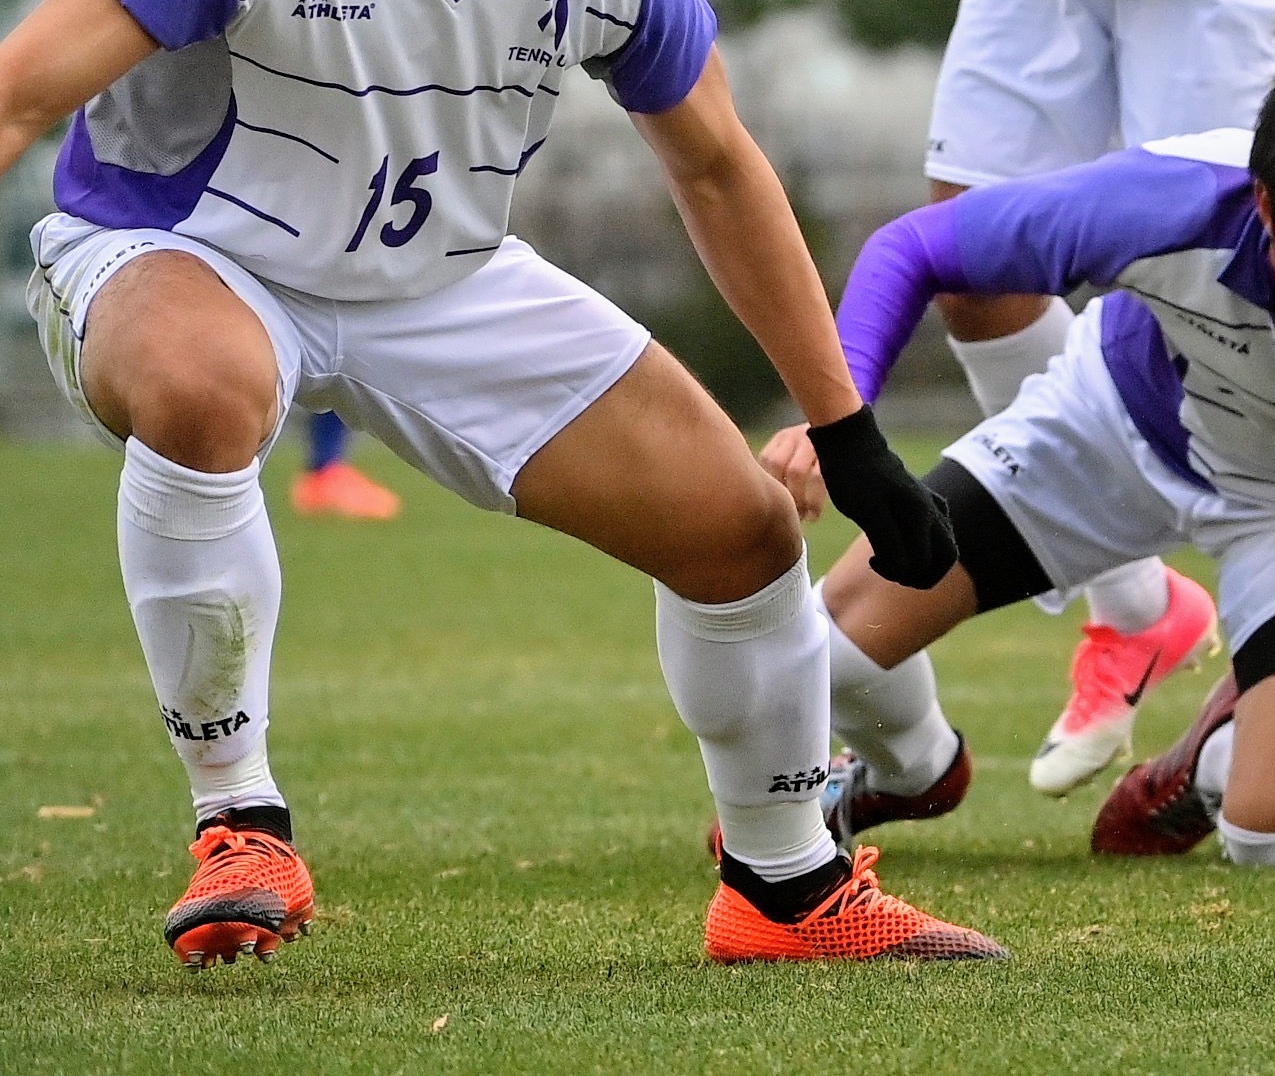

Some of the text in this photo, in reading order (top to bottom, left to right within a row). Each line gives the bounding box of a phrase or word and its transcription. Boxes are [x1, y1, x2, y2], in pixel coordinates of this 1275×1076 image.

[291, 3, 371, 21] ATHLETA
[507, 46, 553, 67] TENR
[345, 150, 440, 253] 15
